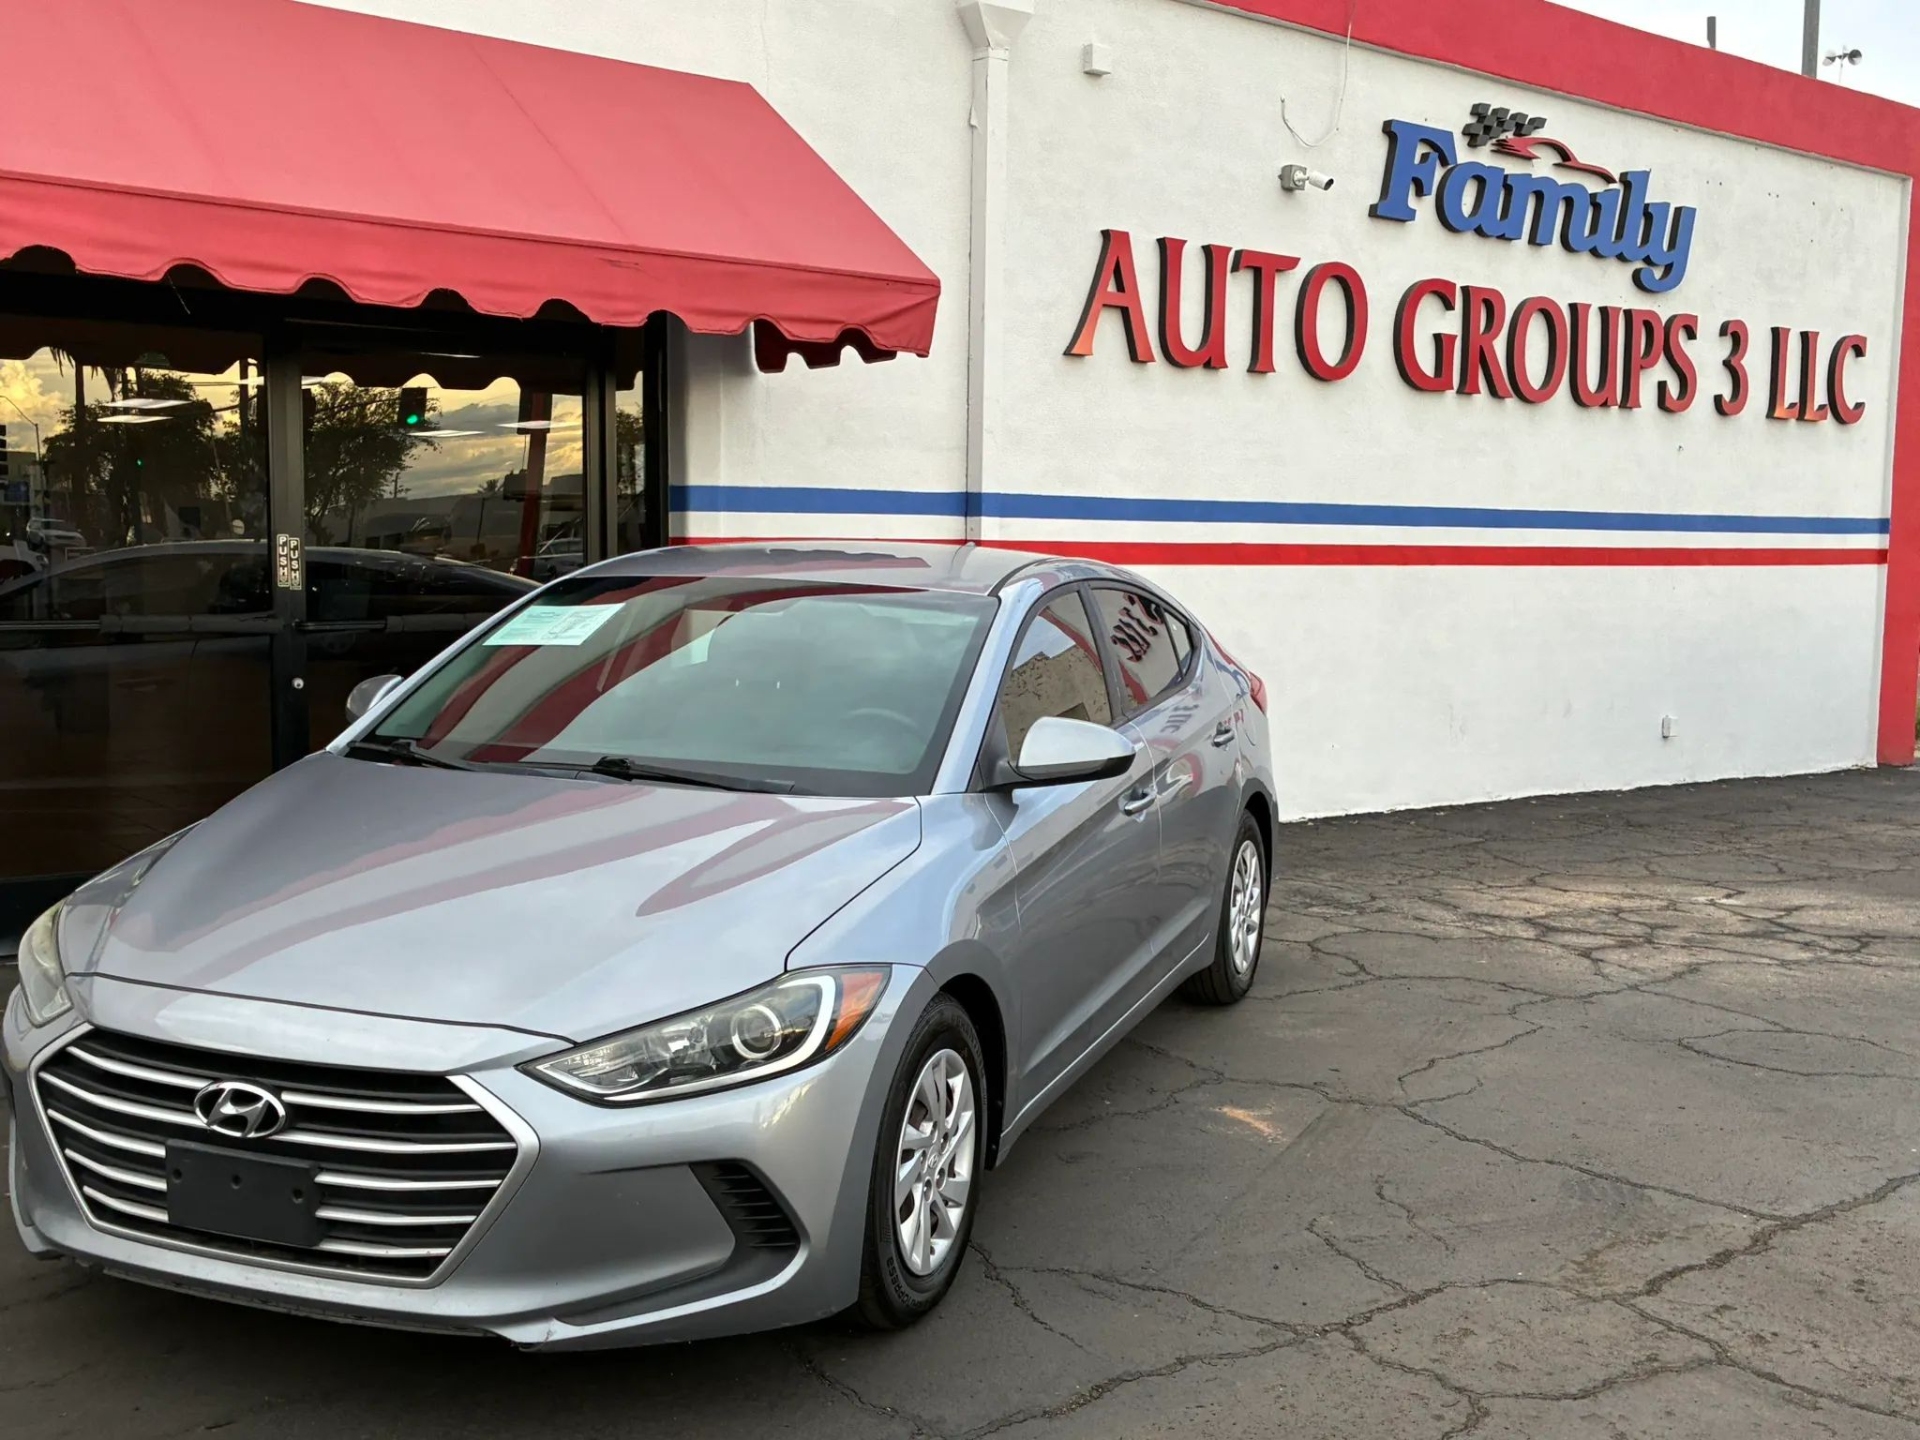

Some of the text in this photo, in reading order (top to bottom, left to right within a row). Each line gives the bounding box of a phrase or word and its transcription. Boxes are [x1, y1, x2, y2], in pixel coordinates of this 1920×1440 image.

[1369, 119, 1697, 293] Family
[1063, 229, 1868, 424] AUTO GROUPS 3 LLC
[279, 536, 288, 576] PUSH
[290, 540, 299, 580] PUSH
